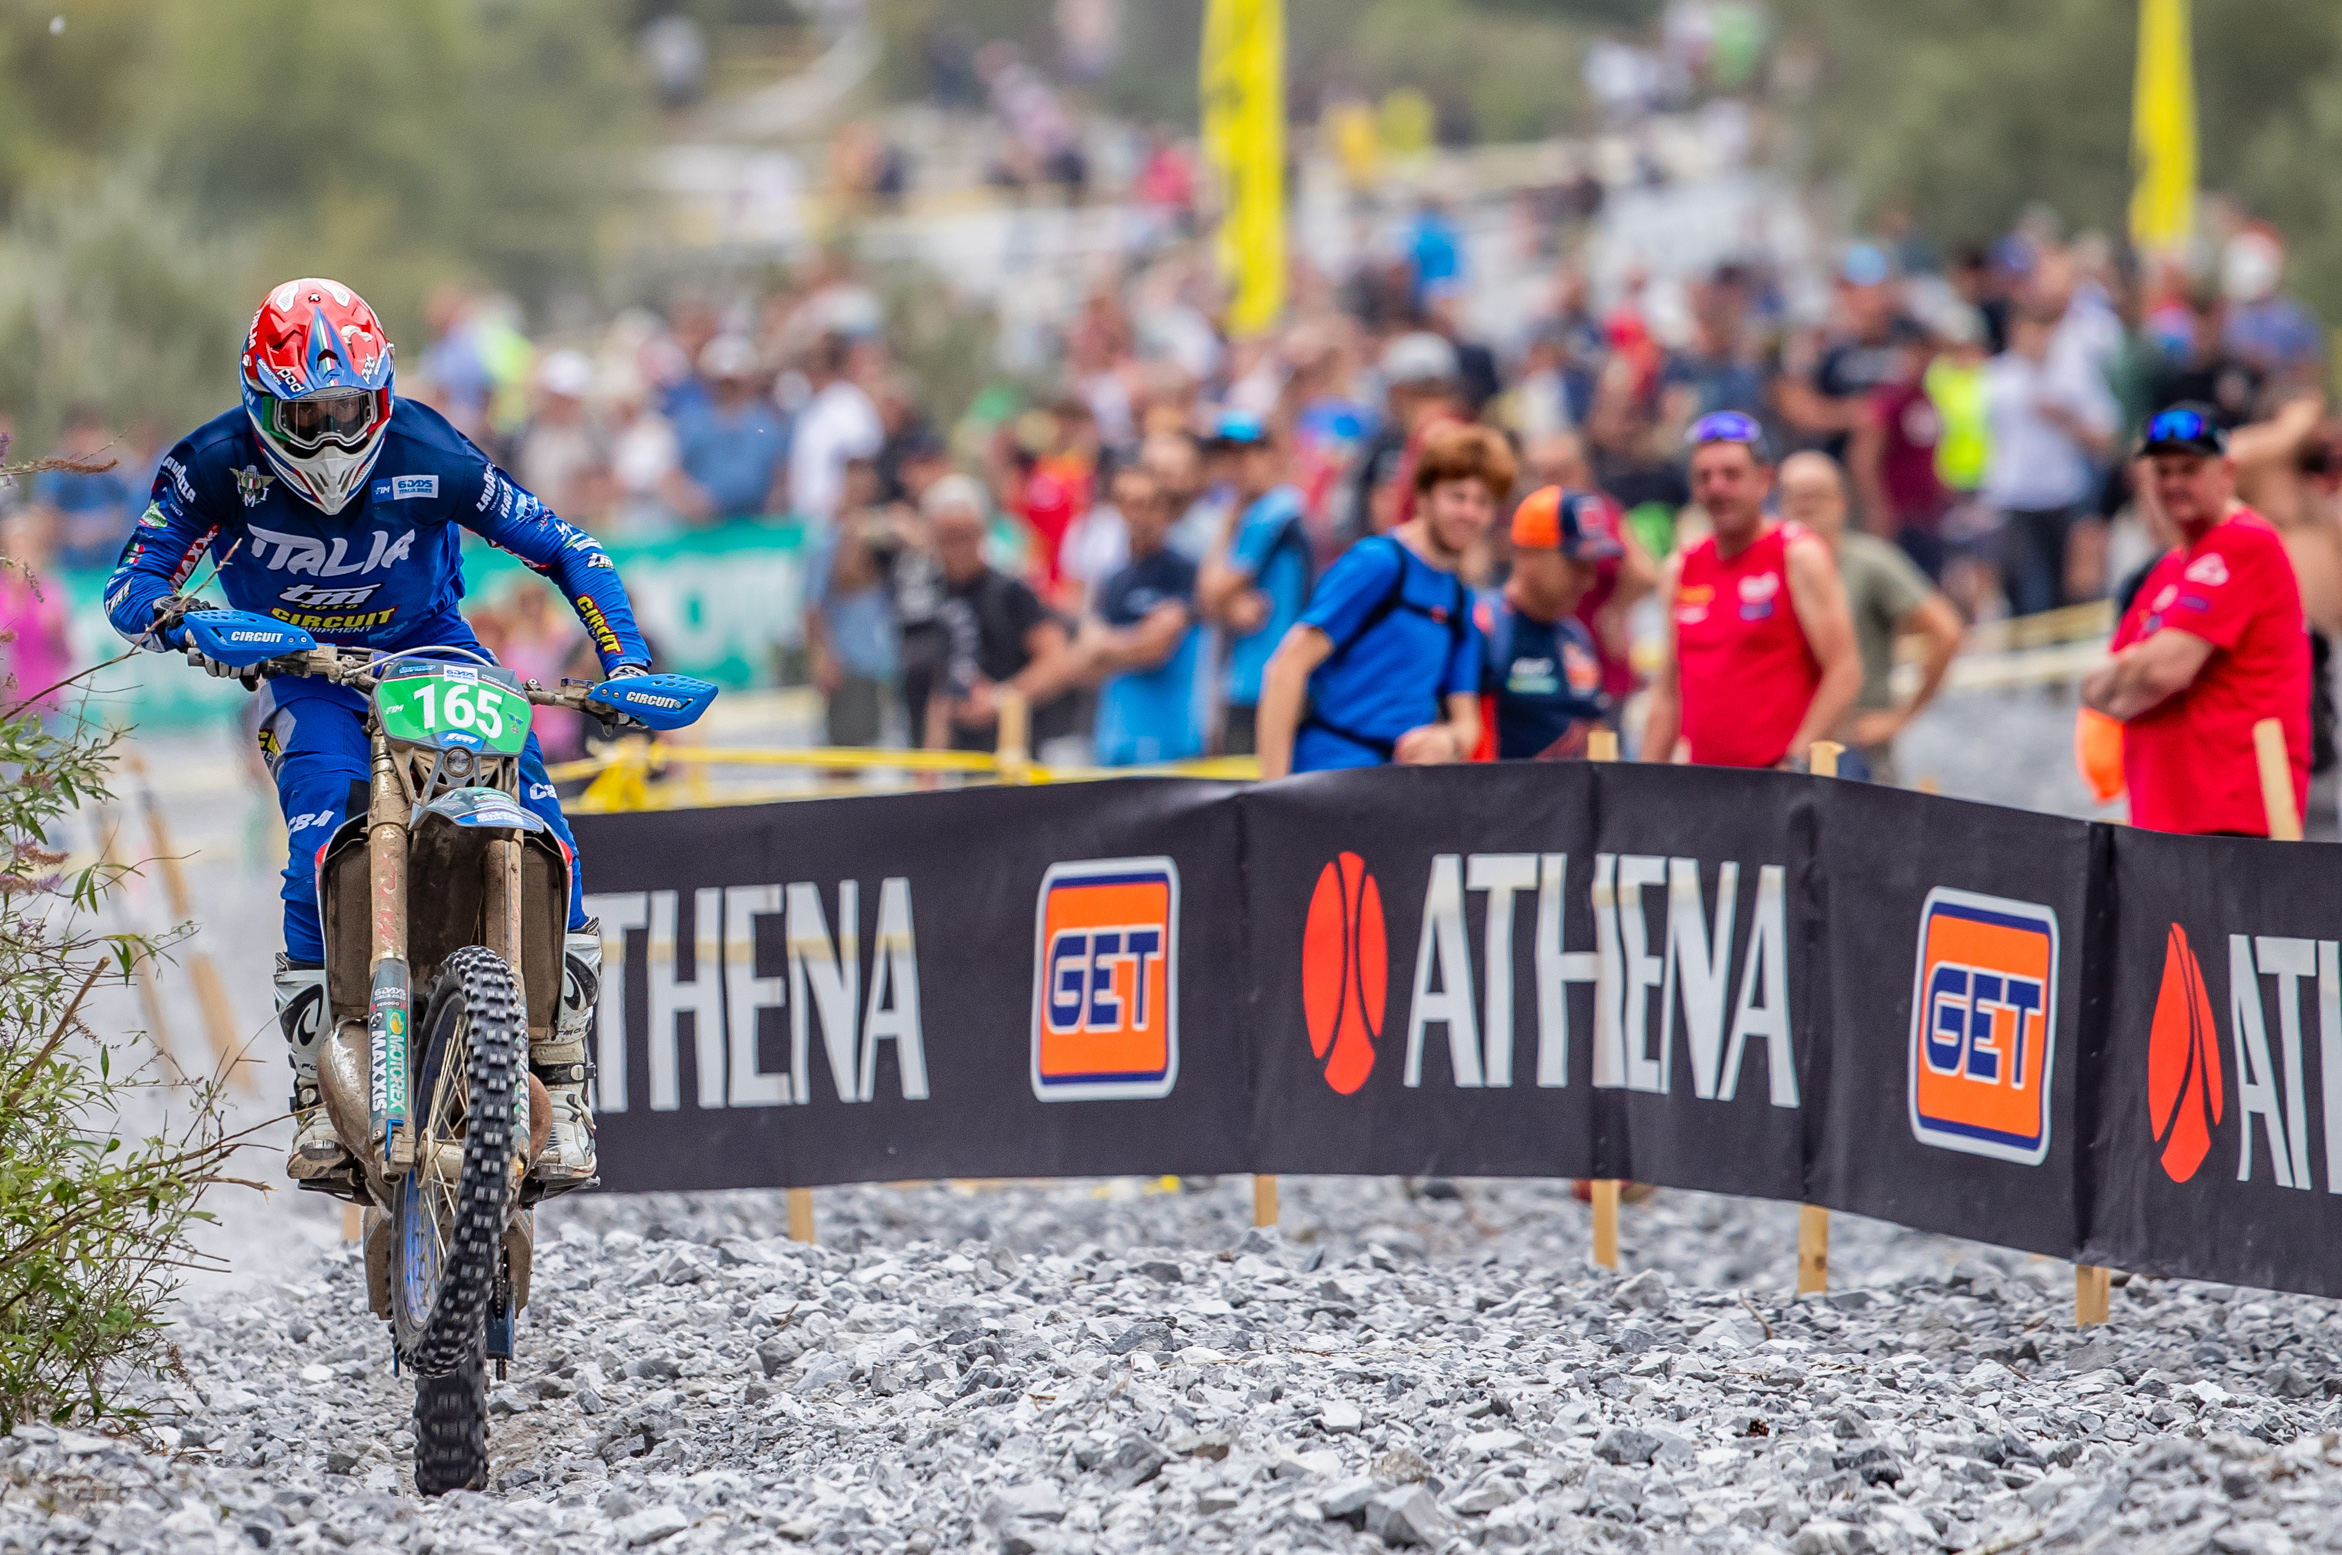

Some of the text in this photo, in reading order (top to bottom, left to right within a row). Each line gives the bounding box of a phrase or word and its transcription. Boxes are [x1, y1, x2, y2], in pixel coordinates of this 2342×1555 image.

[162, 456, 197, 504] AVAZZA
[247, 523, 416, 577] ITALIA
[270, 607, 396, 628] CIRCUIT
[297, 603, 358, 611] MOTO
[230, 631, 284, 644] CIRCUIT
[414, 683, 503, 739] 165
[626, 690, 677, 709] CIRCUIT
[582, 876, 930, 1114] THENA
[1045, 923, 1164, 1035] GET
[1403, 852, 1800, 1108] ATHENA
[1924, 960, 2045, 1091] GET
[371, 1030, 388, 1113] MAXXIS
[389, 1034, 406, 1112] MOTOREX
